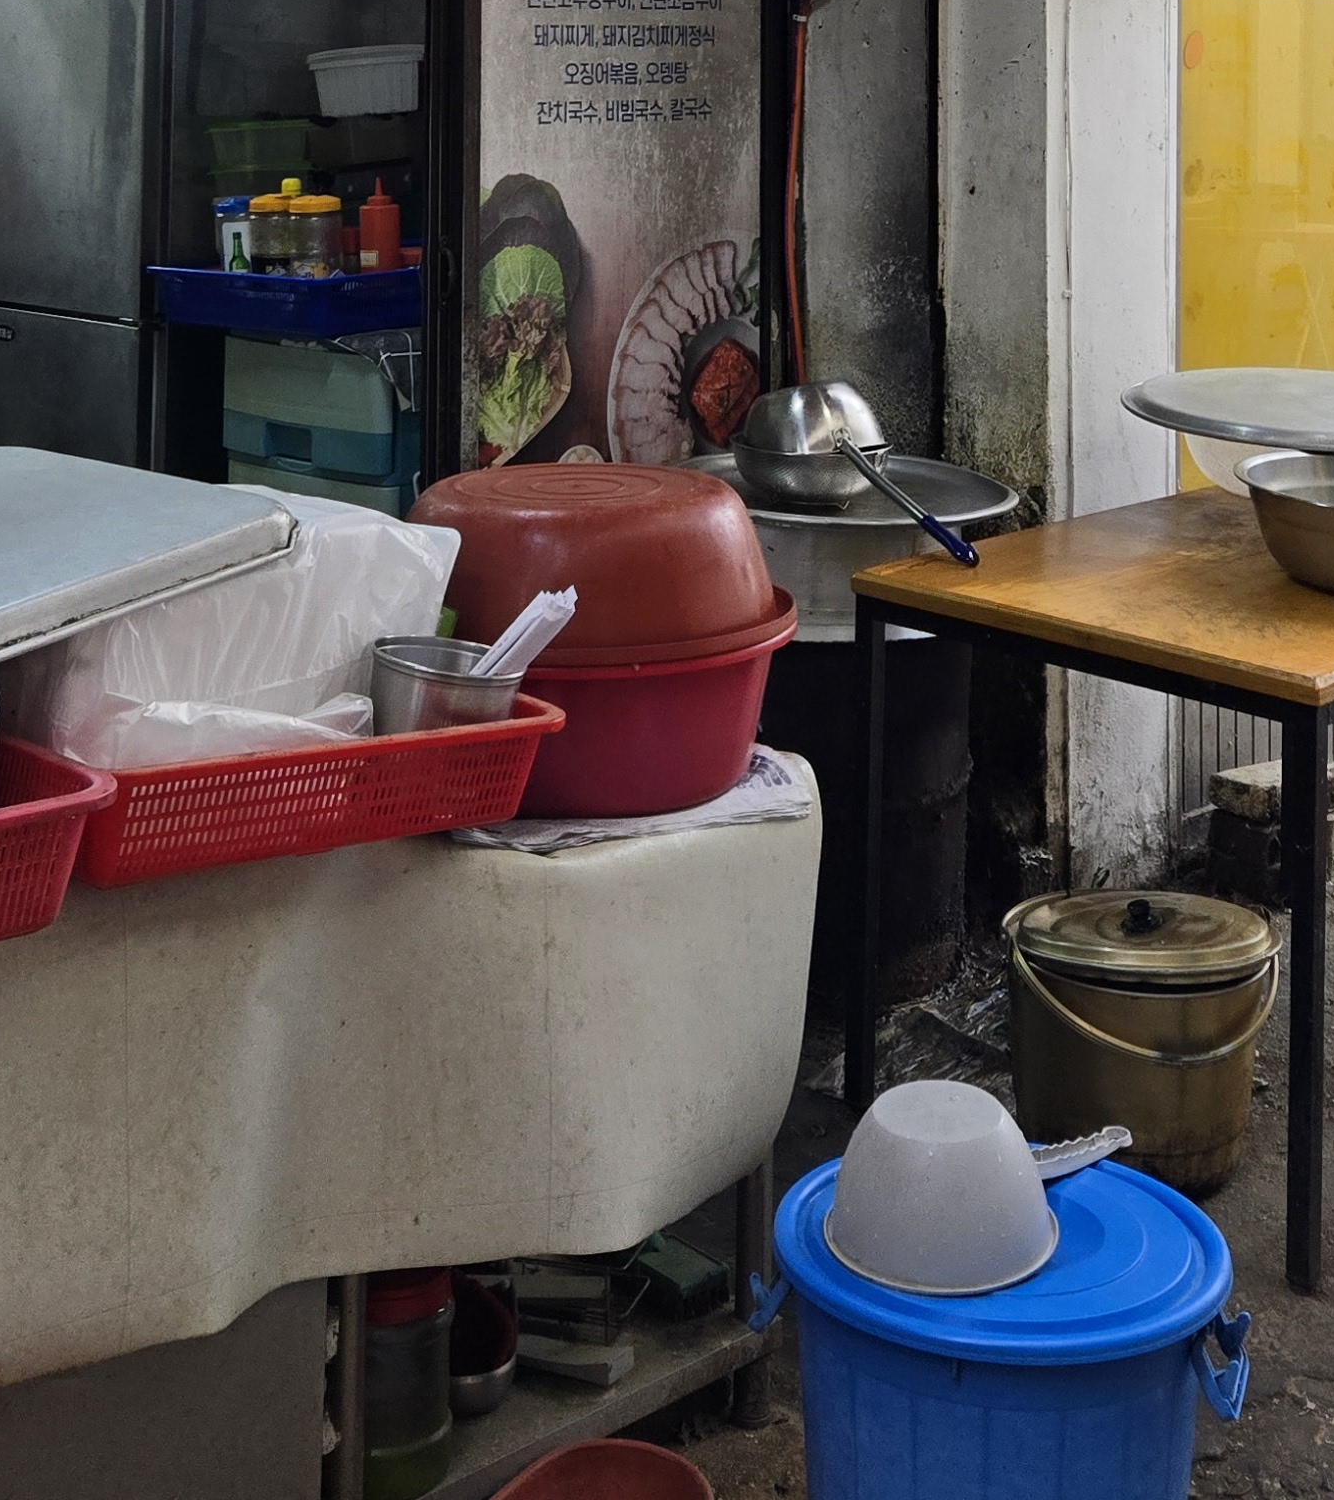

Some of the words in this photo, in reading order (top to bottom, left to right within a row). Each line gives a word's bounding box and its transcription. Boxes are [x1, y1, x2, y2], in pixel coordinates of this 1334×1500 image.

[564, 62, 642, 86] 오징어볶음,
[645, 61, 689, 85] 오뎅탕
[537, 101, 601, 125] 잔치국수,
[605, 98, 667, 123] 비빔국수,
[670, 98, 713, 122] 칼국수
